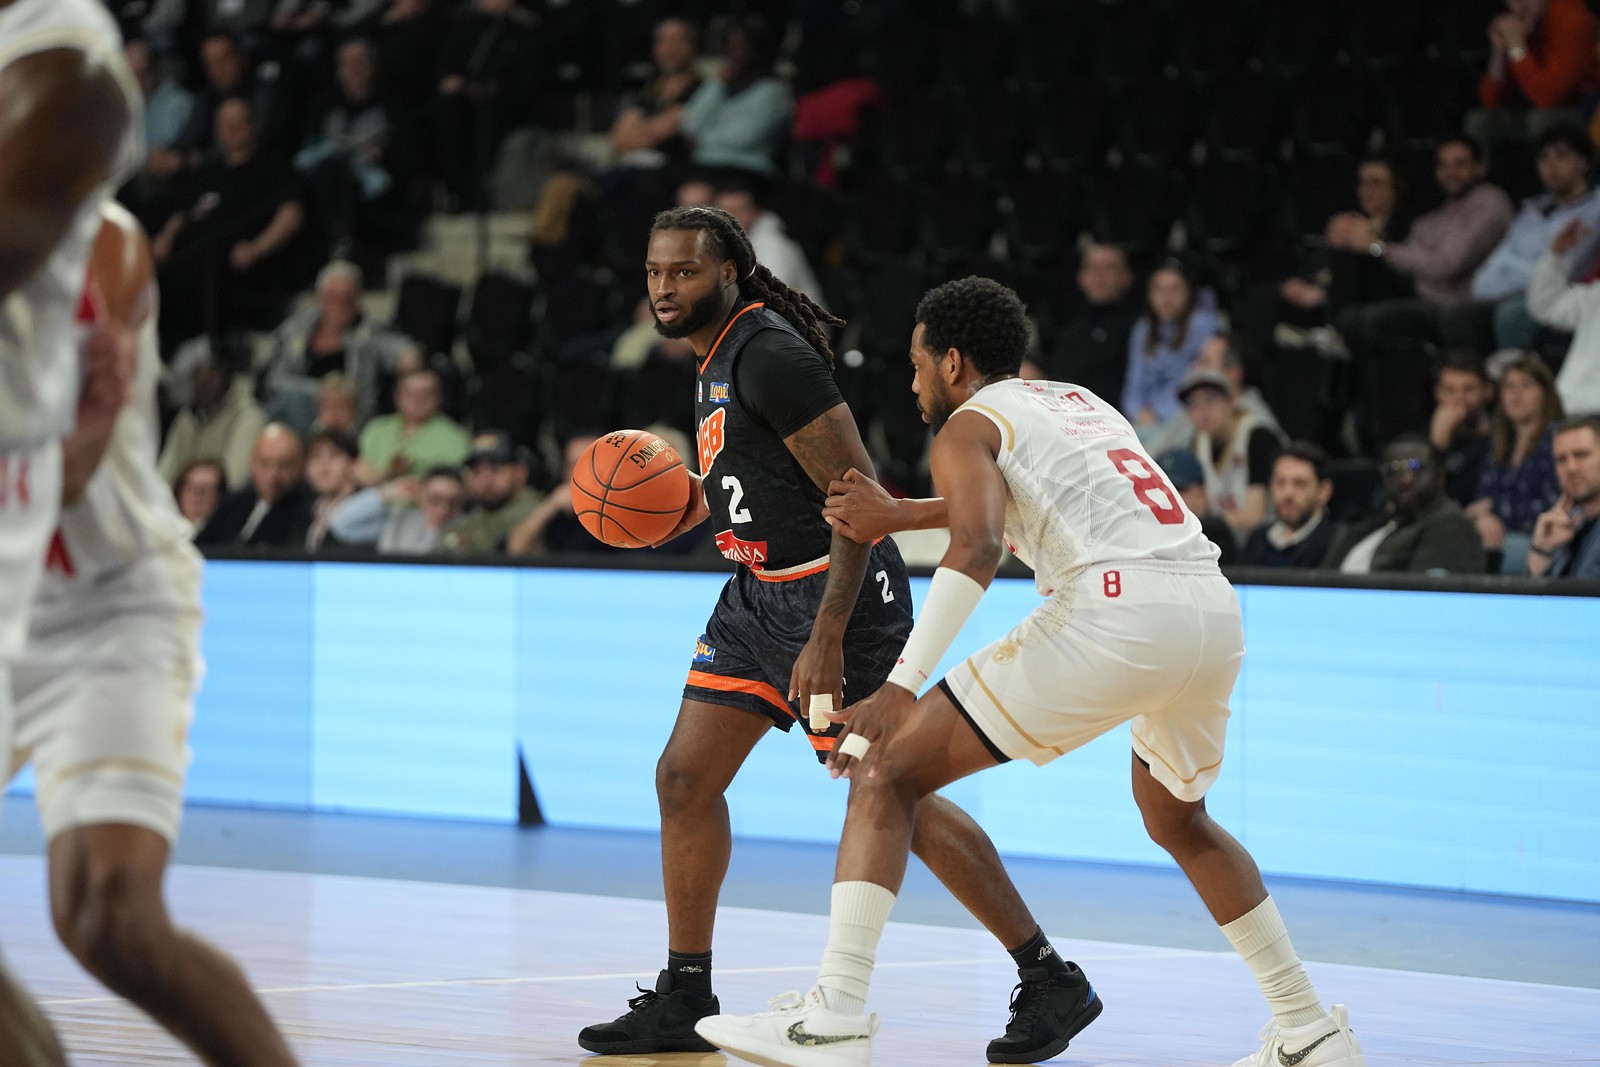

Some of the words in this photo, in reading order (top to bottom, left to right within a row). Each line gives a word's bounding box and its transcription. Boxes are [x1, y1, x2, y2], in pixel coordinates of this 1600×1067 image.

[721, 475, 753, 524] 2
[1107, 448, 1185, 525] 8
[875, 570, 895, 604] 2
[1103, 570, 1122, 598] 8
